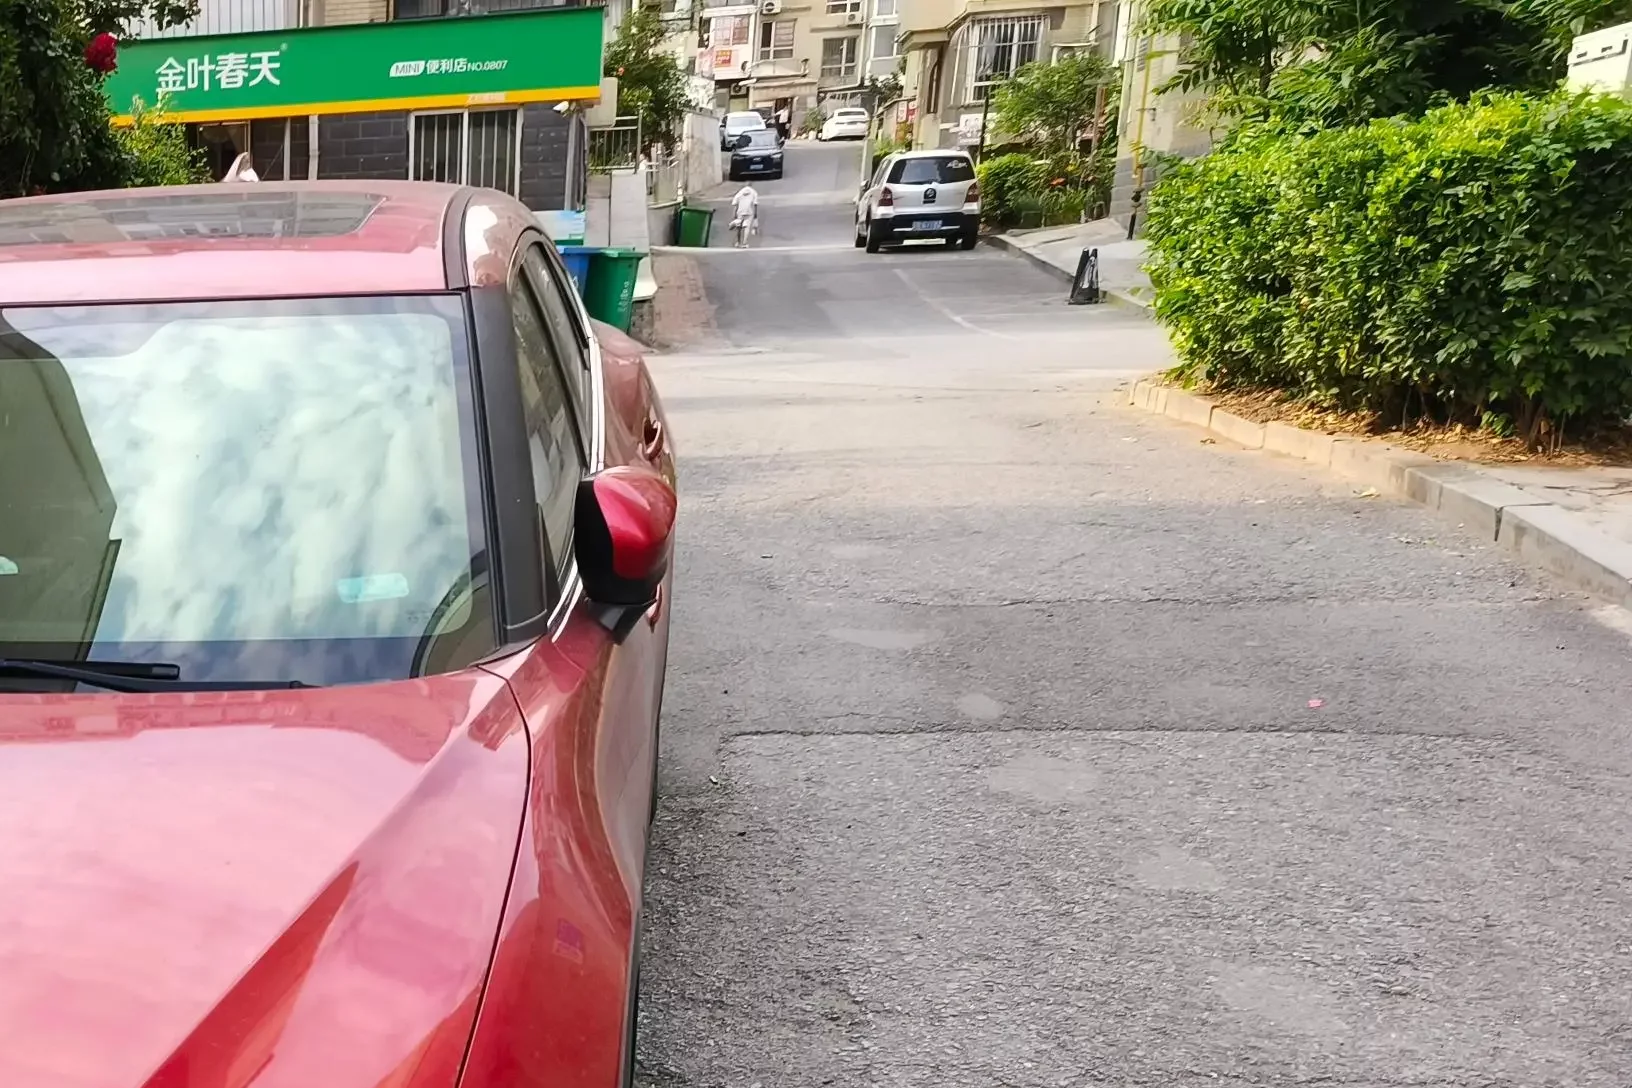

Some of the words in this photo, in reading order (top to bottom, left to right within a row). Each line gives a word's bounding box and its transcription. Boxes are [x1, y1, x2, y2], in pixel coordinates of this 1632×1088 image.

[155, 51, 281, 92] 金叶春天
[395, 62, 421, 75] MINI
[426, 58, 468, 74] 便利店
